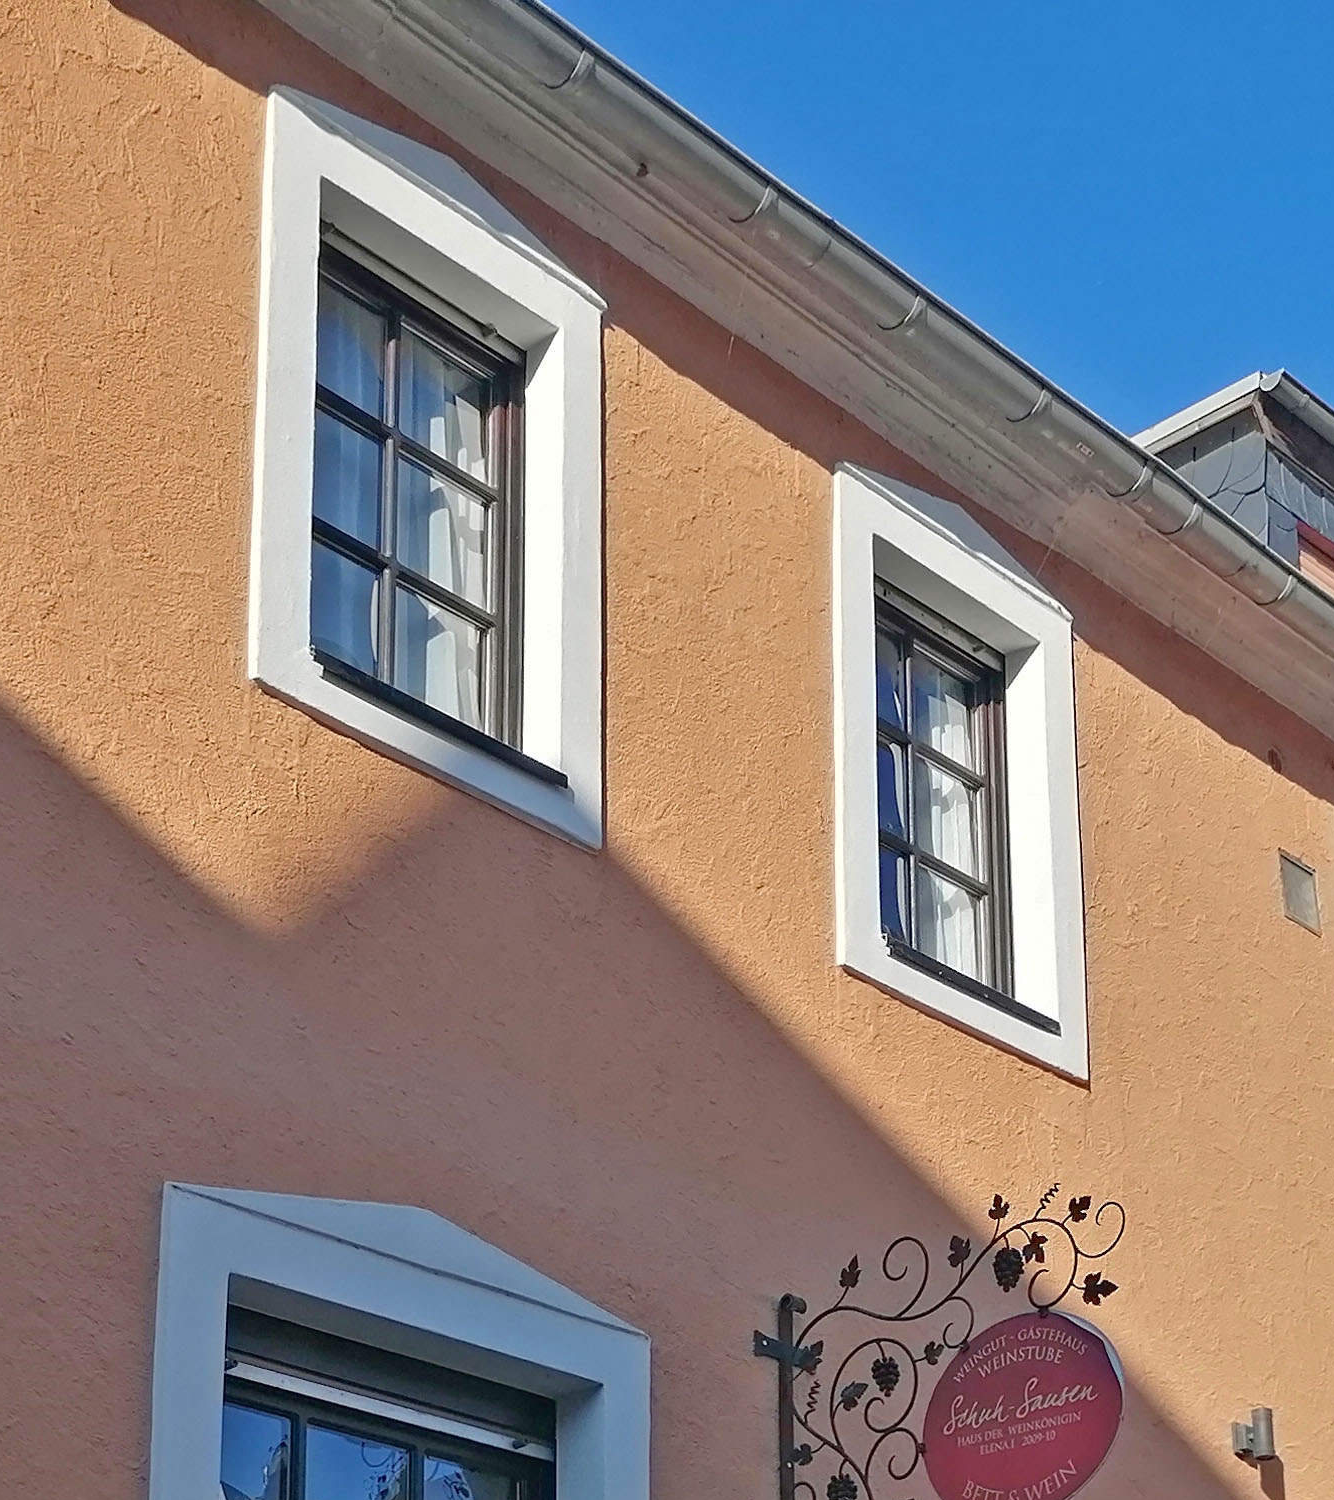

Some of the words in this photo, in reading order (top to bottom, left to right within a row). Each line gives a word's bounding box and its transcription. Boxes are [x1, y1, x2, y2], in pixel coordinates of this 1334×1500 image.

[953, 1335, 1007, 1383] WEINGUT
[1017, 1326, 1088, 1356] GÄSTEHAUS
[977, 1345, 1064, 1379] WEINSTUBE
[957, 1433, 982, 1448] HAUS
[984, 1429, 1004, 1442] DER
